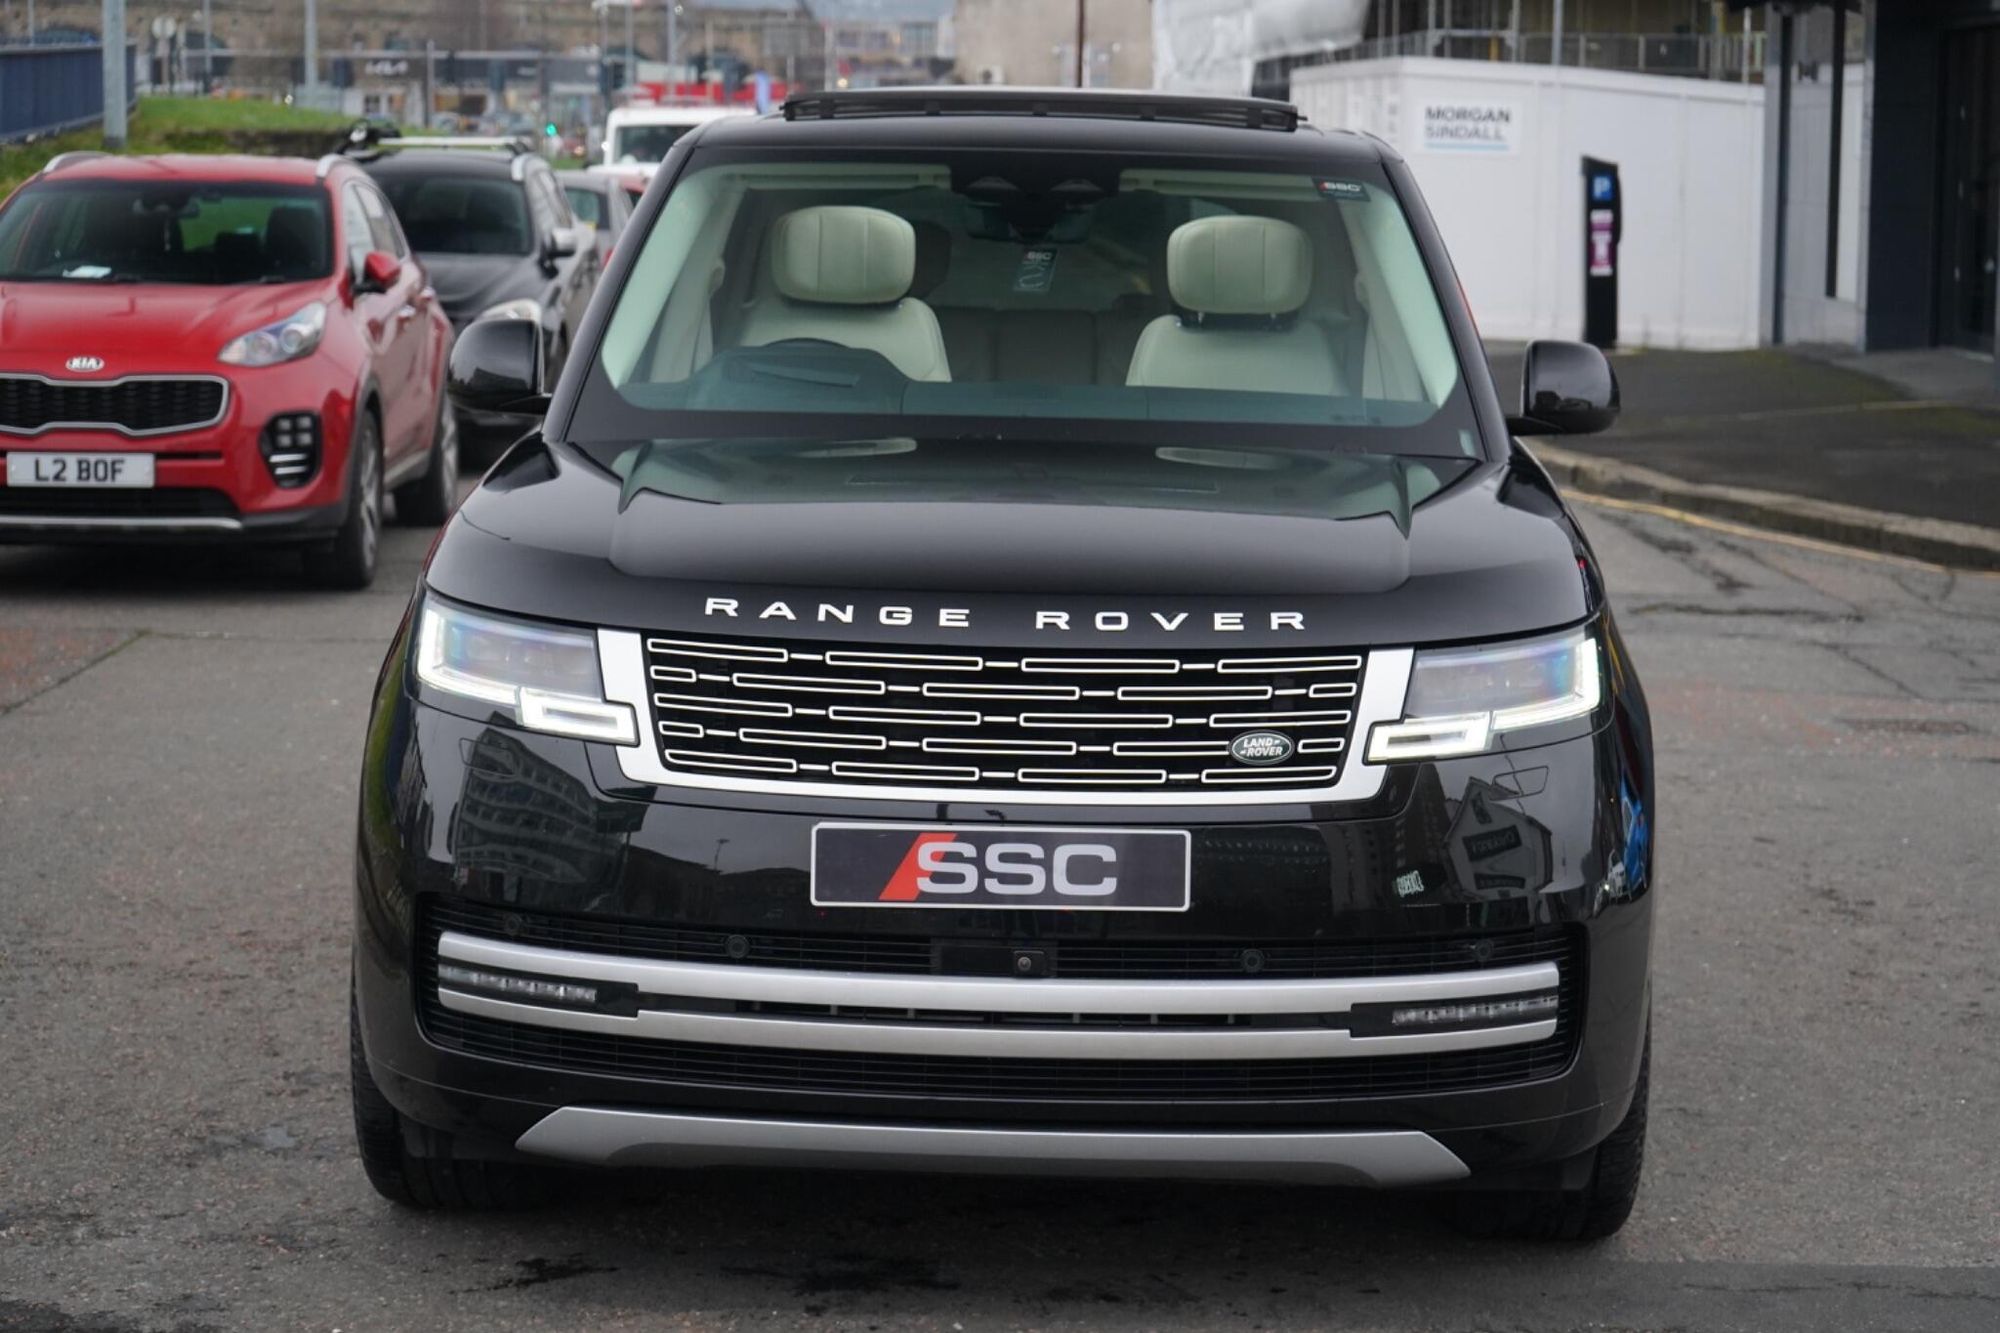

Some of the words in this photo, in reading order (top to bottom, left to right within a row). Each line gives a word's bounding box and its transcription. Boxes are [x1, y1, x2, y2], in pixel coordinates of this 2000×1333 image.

[1425, 105, 1511, 122] MORGAN
[1425, 126, 1504, 140] SINDALL
[1323, 182, 1361, 192] SSC
[1593, 176, 1611, 198] P
[71, 356, 99, 369] KIA
[34, 458, 67, 482] L2
[76, 458, 125, 482] BOF
[704, 597, 970, 628] RANGE
[1035, 610, 1305, 631] ROVER
[1243, 737, 1273, 748] LAND
[1247, 746, 1283, 757] ROVER
[916, 841, 1118, 896] SSC
